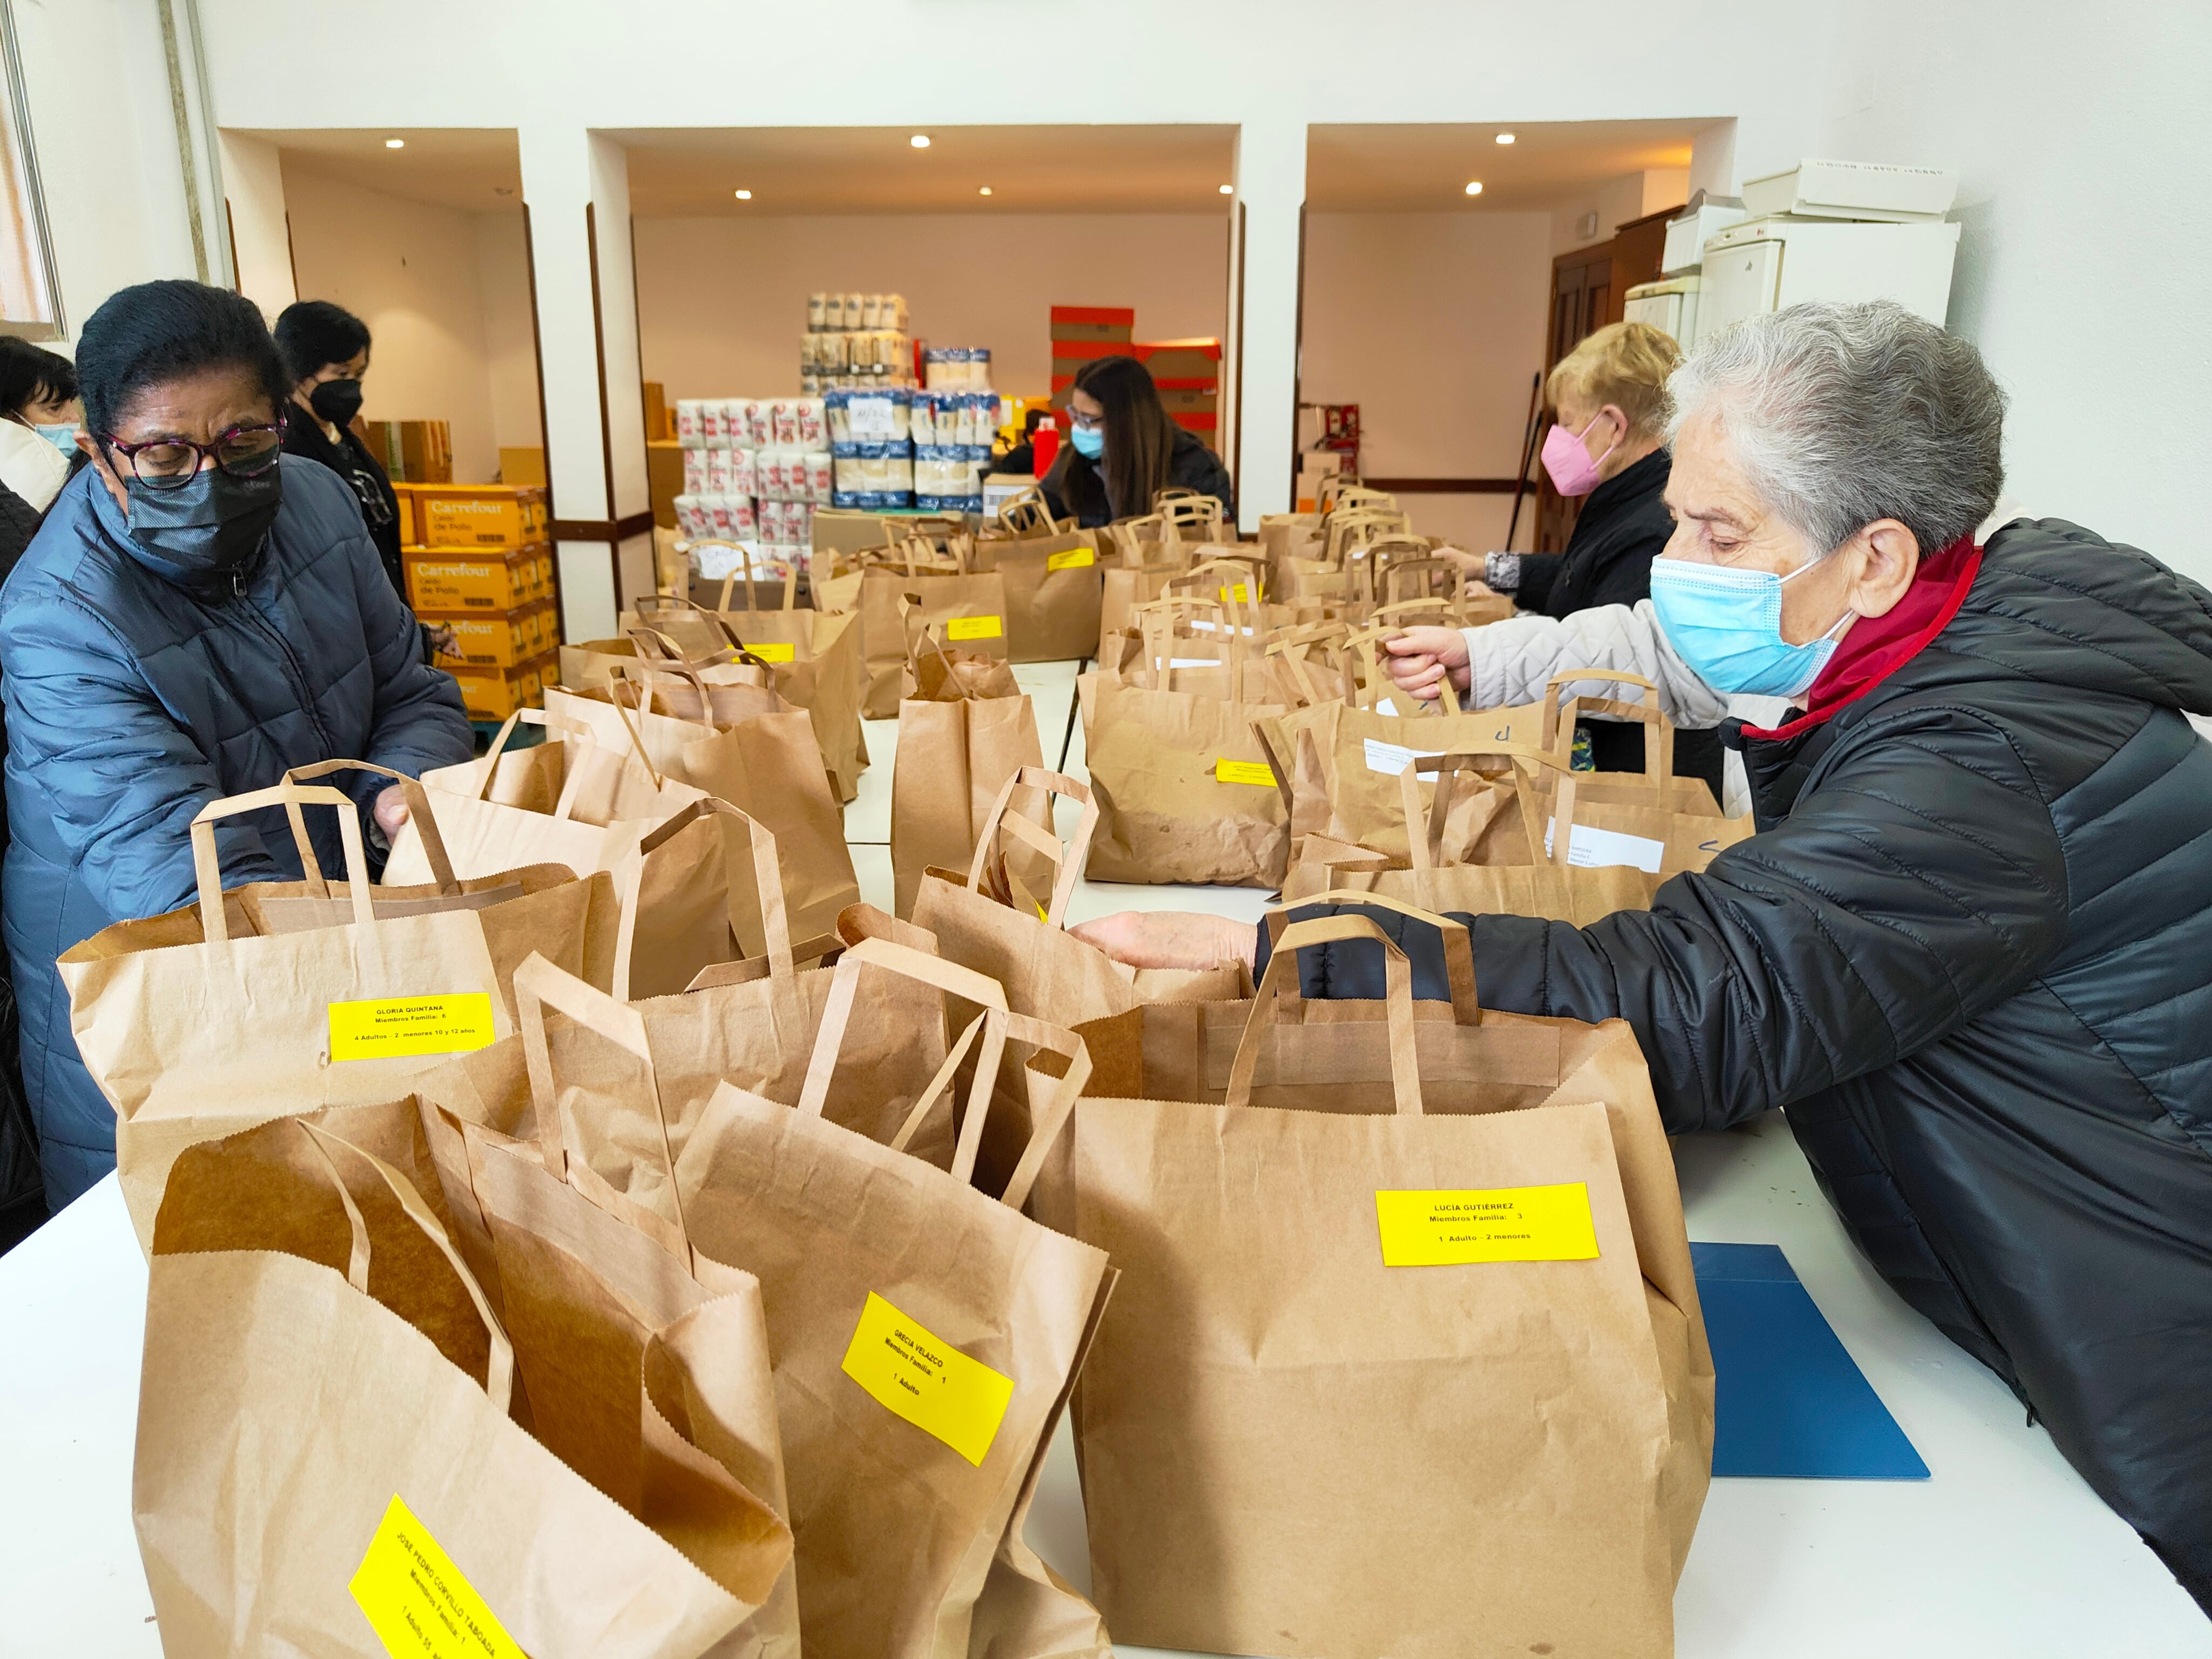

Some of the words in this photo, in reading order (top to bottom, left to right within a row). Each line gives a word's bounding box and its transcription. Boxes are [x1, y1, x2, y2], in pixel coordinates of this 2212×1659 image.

[431, 501, 502, 514] Carrefour
[417, 562, 489, 576] Carrefour
[885, 1337, 909, 1359] Miembros
[909, 1355, 933, 1376] Familia:
[894, 1329, 914, 1348] GRECIA
[915, 1344, 943, 1367] VELAZCO
[899, 1378, 920, 1395] Adulto
[410, 1568, 436, 1607] Miembros
[461, 1637, 466, 1645] 1
[413, 1549, 434, 1578] PEDRO
[434, 1576, 464, 1617] CORVILLO
[465, 1615, 495, 1658] TABOADA
[406, 1611, 423, 1640] Adulto
